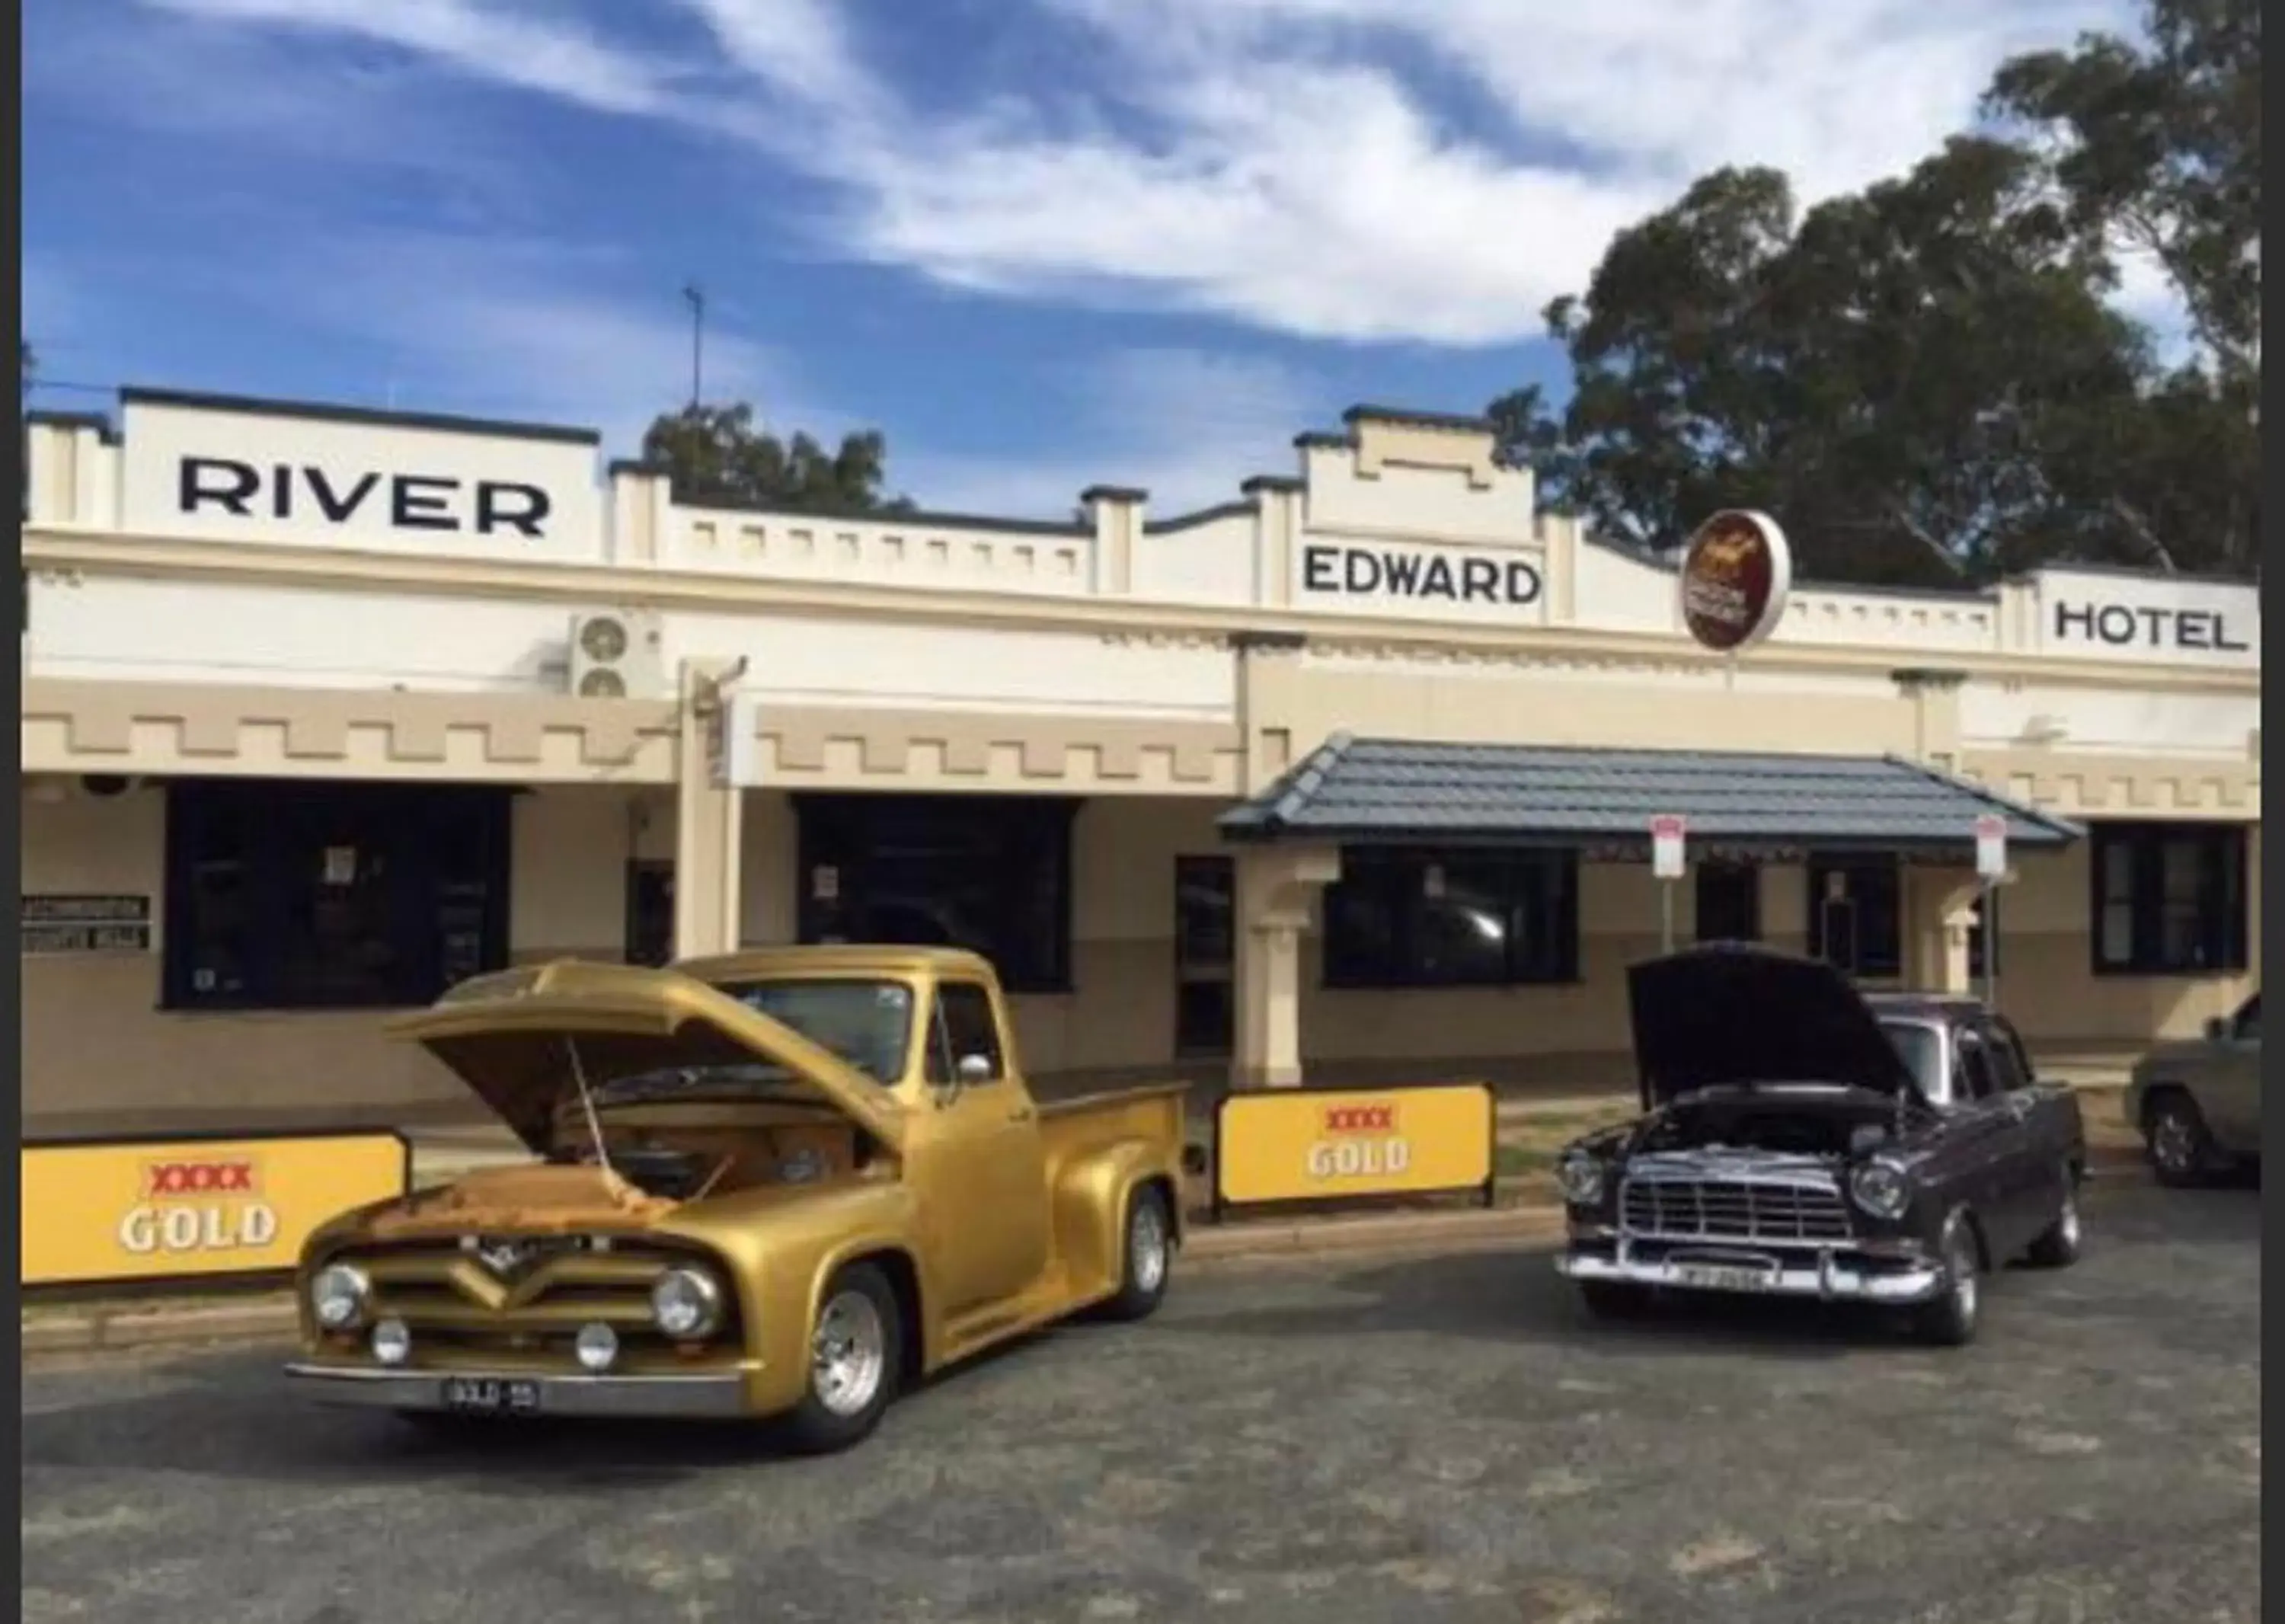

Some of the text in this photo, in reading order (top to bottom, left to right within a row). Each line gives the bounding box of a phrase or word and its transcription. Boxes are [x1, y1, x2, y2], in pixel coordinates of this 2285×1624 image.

[179, 455, 551, 538] RIVER
[1303, 545, 1542, 605] EDWARD
[2054, 599, 2252, 653] HOTEL
[151, 1162, 251, 1194] XXXX
[1307, 1139, 1411, 1176] GOLD
[120, 1204, 277, 1252] GOLD
